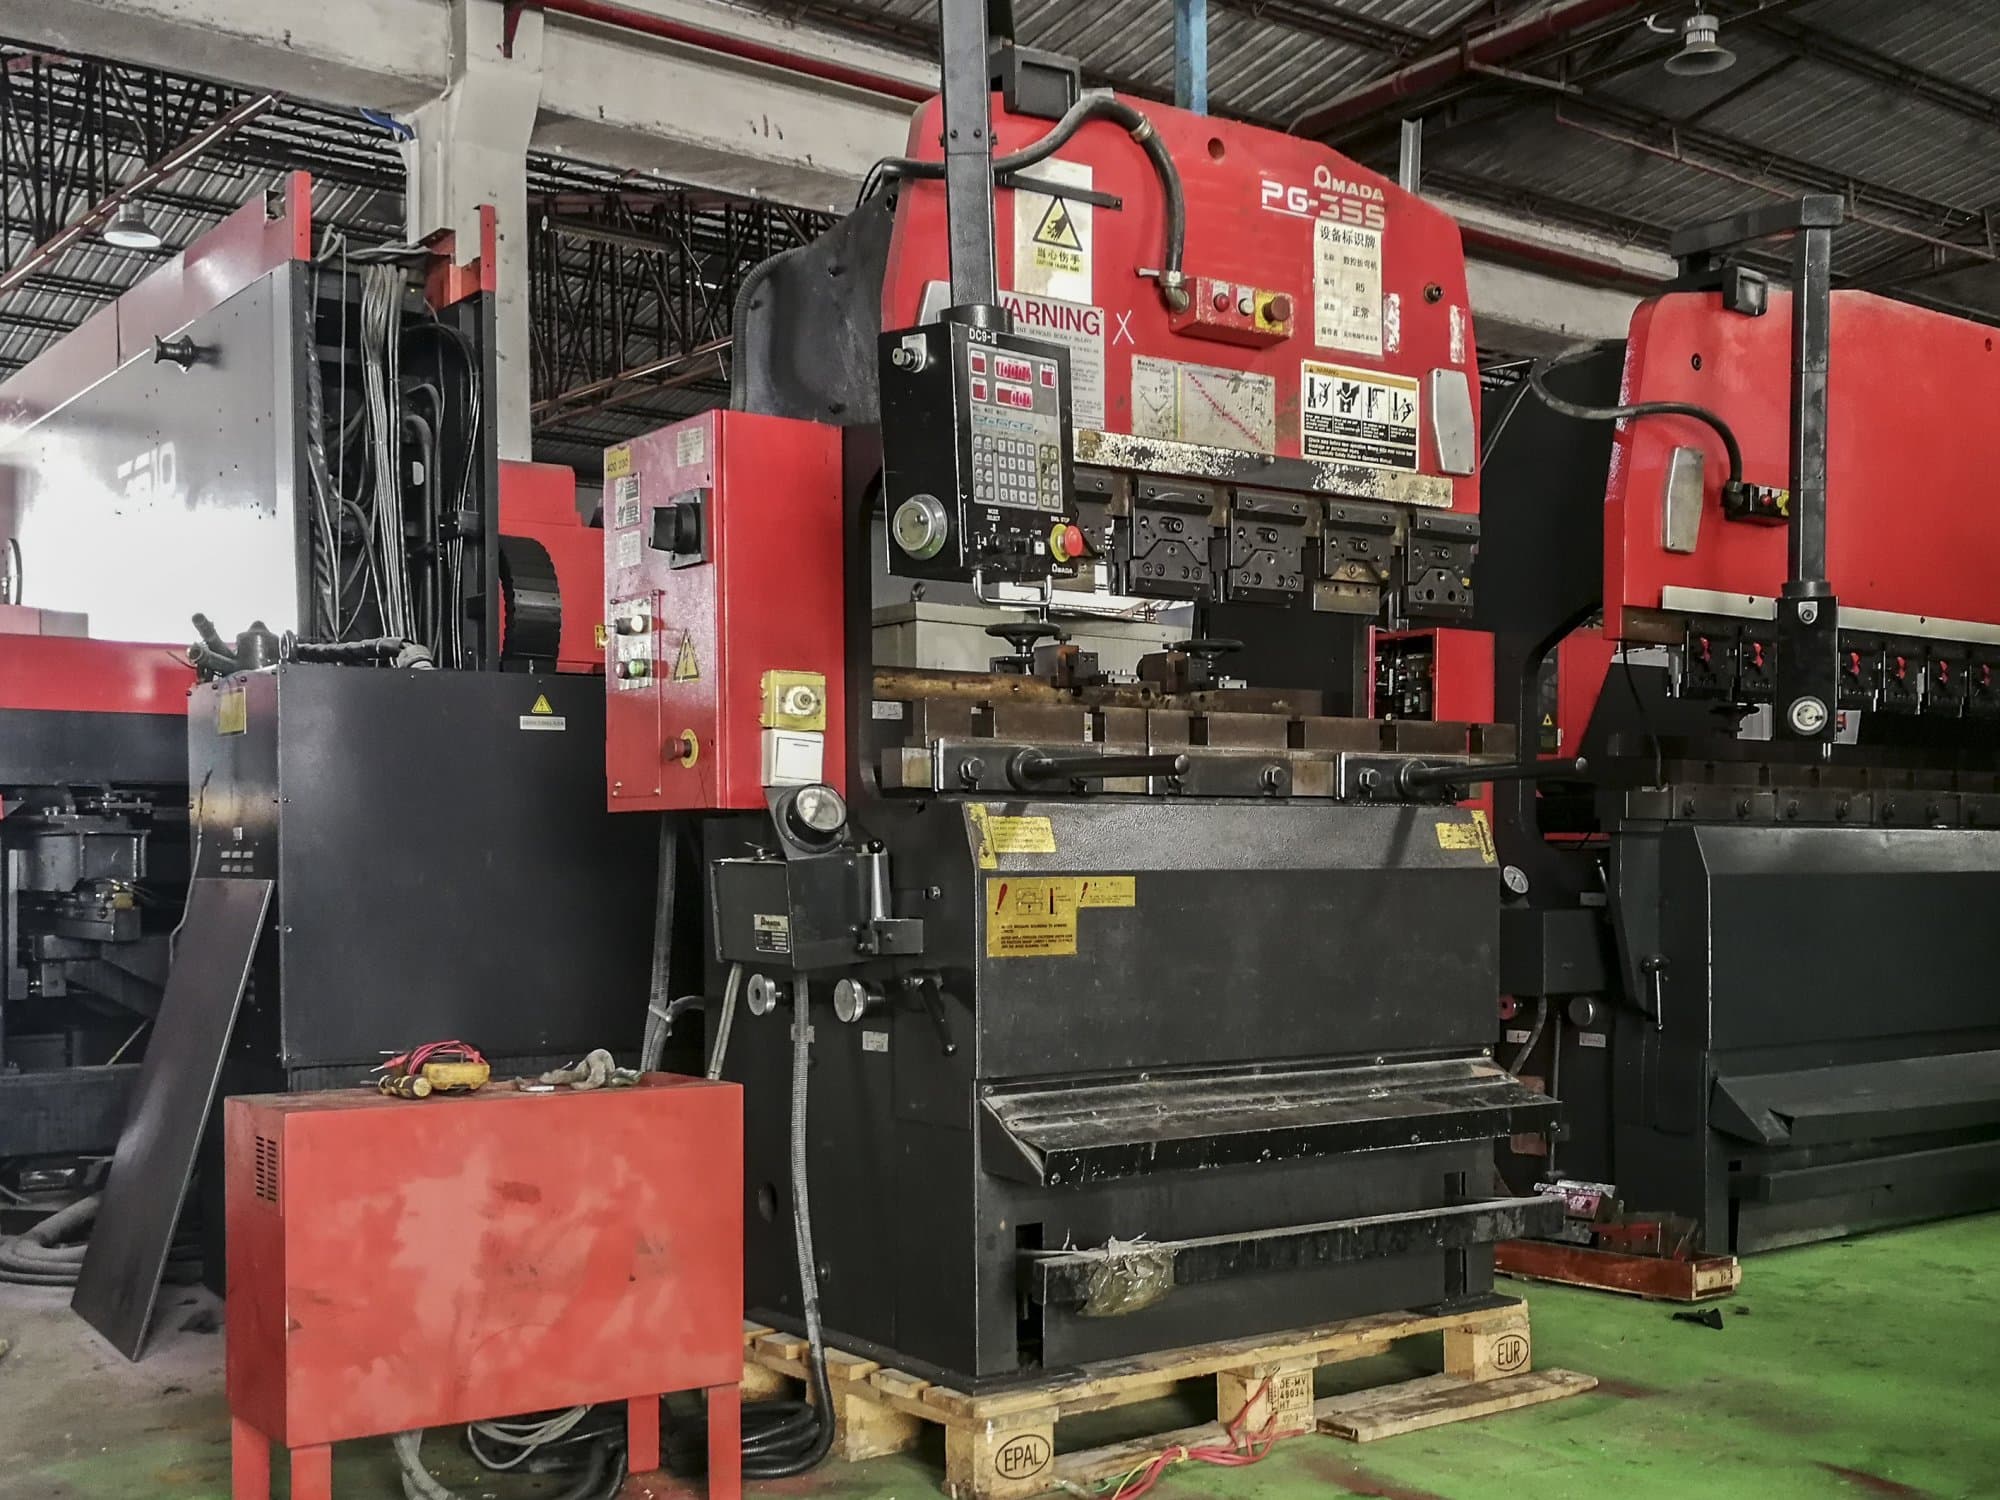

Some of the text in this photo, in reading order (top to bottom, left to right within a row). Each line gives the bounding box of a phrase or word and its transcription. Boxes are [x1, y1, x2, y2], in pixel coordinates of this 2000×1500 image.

[1314, 165, 1384, 201] AMADA
[1320, 225, 1376, 249] 设备标识牌
[999, 296, 1100, 336] ARNING
[1352, 305, 1370, 319] 正常
[1498, 1340, 1520, 1366] EUR
[1004, 1443, 1043, 1473] EPAL
